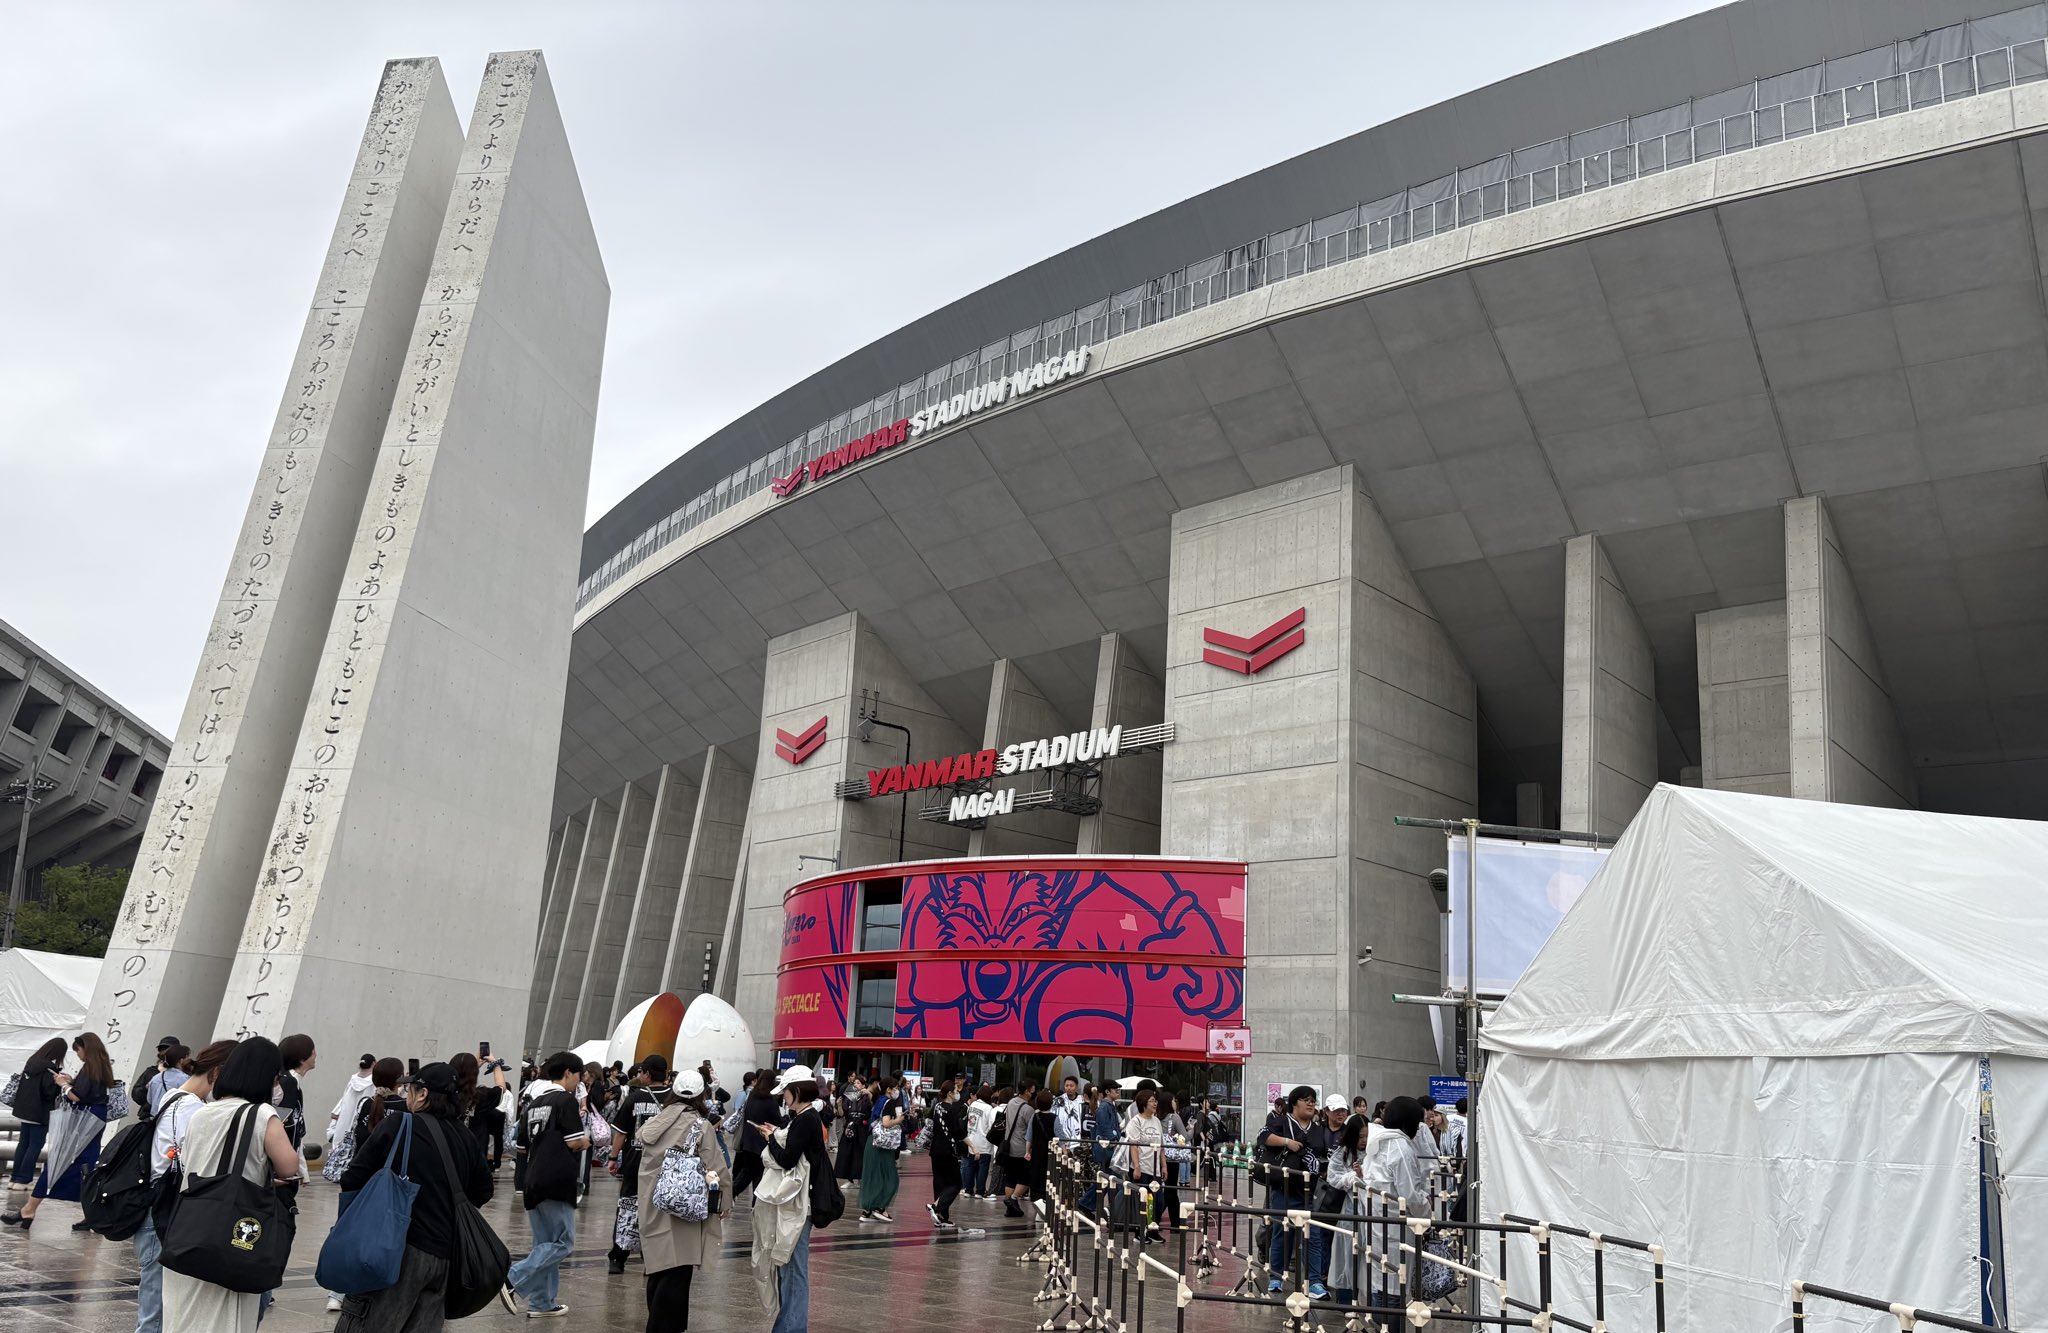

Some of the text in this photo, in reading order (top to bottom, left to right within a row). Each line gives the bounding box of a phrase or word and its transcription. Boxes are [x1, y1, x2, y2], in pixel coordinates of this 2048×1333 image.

[452, 74, 514, 253] こころよりからだへ
[807, 345, 1091, 481] YANMAR STADIUM NAGAI
[106, 80, 412, 1066] からだよりこころへ こころわがたのもしきものたづさへてはしりたたへむこのつち
[867, 724, 1122, 797] YANMAR STADIUM
[948, 788, 1016, 821] NAGAI
[782, 992, 821, 1015] SPECTACLE
